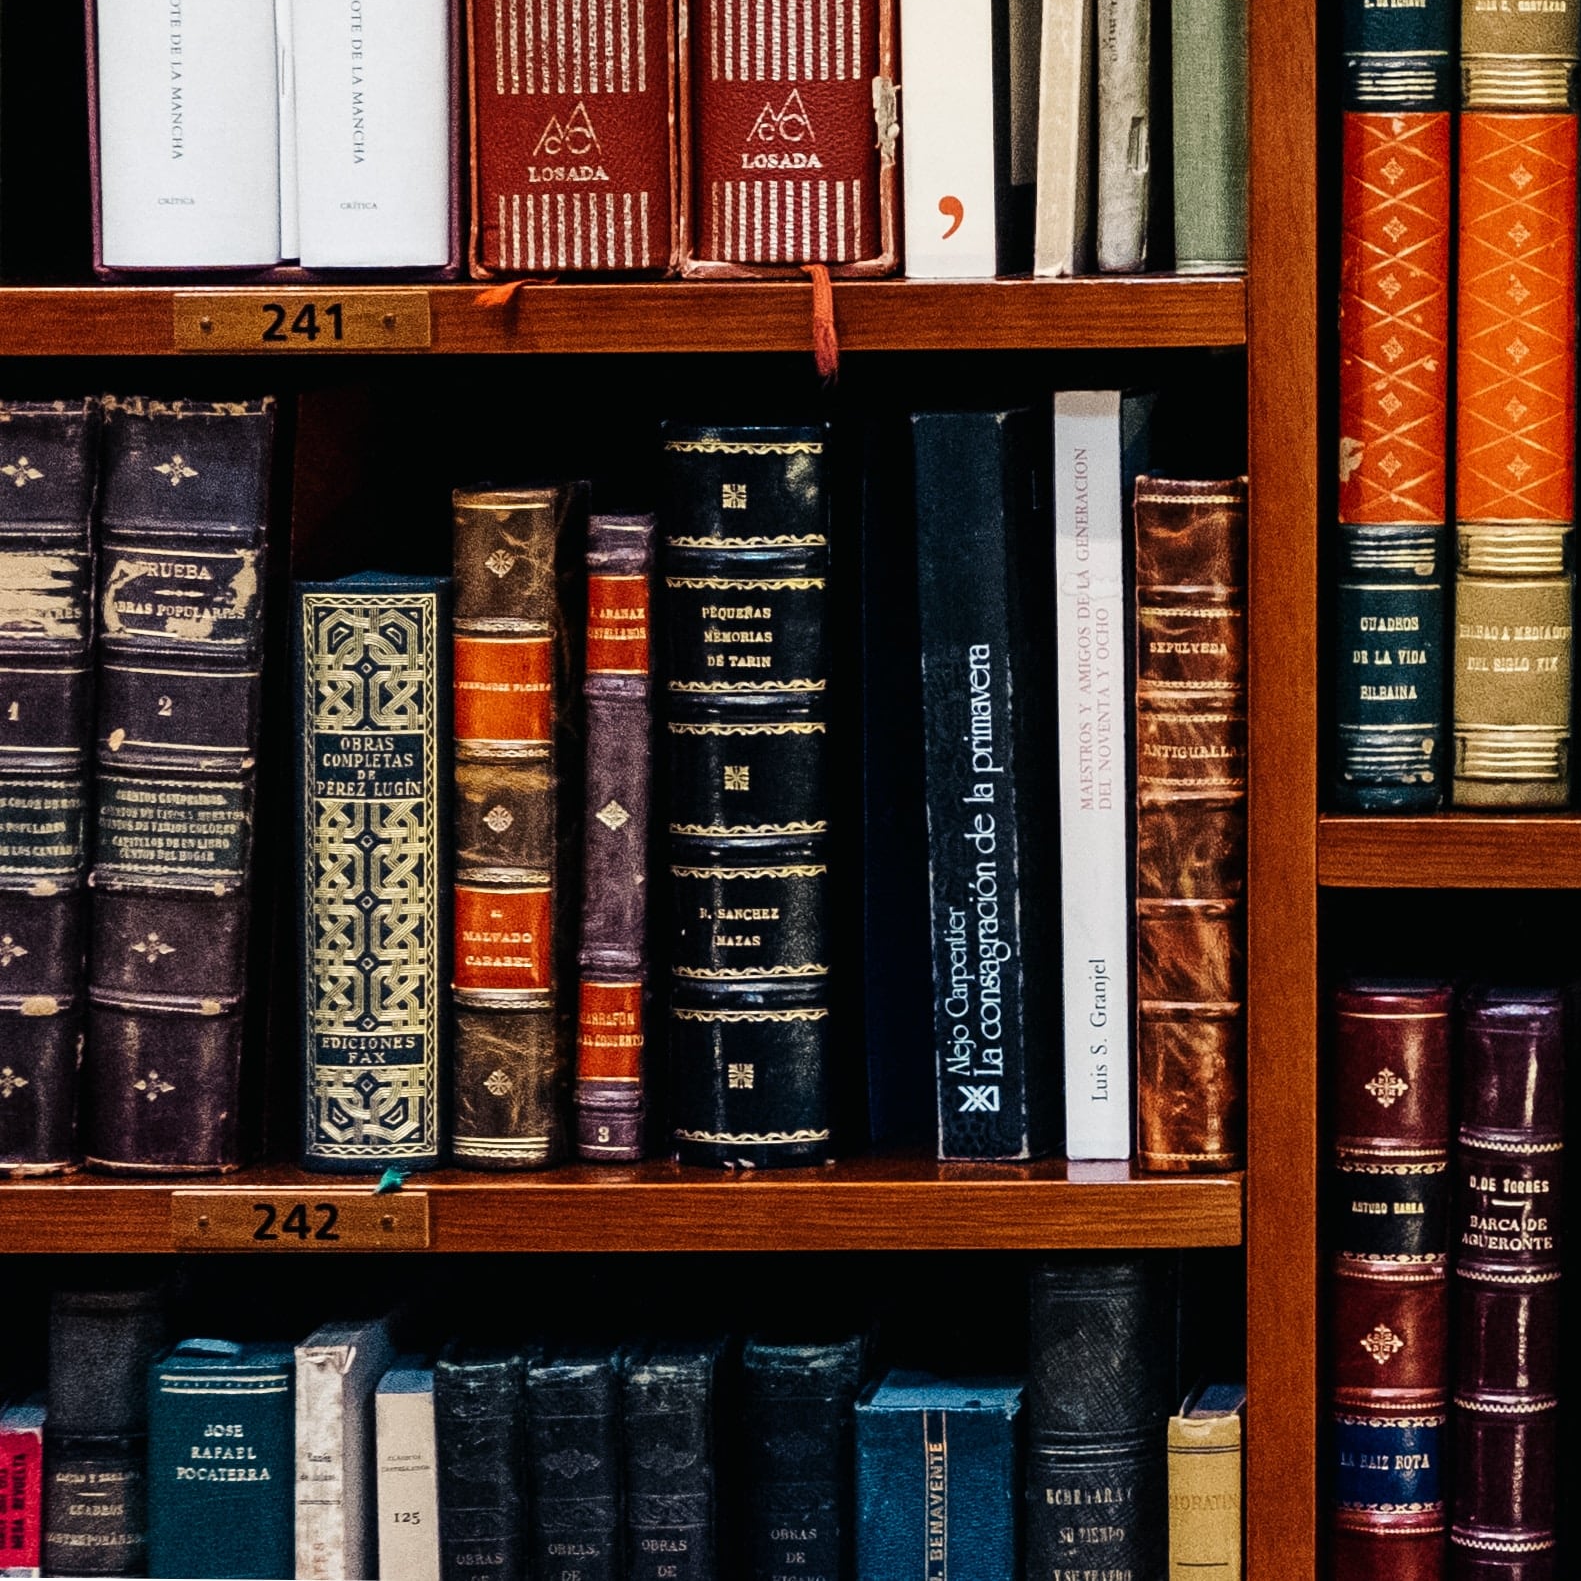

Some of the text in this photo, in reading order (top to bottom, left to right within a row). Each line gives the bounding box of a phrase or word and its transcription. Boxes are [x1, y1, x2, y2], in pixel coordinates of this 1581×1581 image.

[170, 34, 183, 55] DE
[171, 62, 182, 80] LA
[170, 87, 184, 160] MANCHA
[528, 166, 609, 183] LOSADA
[261, 303, 344, 342] 241
[341, 736, 395, 753] OBRAS
[323, 752, 414, 769] COMPLETAS
[358, 770, 376, 781] DE
[963, 644, 1011, 1078] La consagración de la primavera
[945, 906, 977, 1076] Alejo Carpentier
[1088, 958, 1111, 1102] Luis S. Granjel
[322, 1035, 416, 1050] EDICIONES
[349, 1051, 386, 1065] FAX
[253, 1203, 340, 1241] 242
[204, 1424, 244, 1439] JOSE
[192, 1445, 256, 1461] RAFAEL
[177, 1466, 270, 1482] POCATERRA
[929, 1441, 946, 1562] BENAVENTE
[393, 1511, 420, 1525] 125
